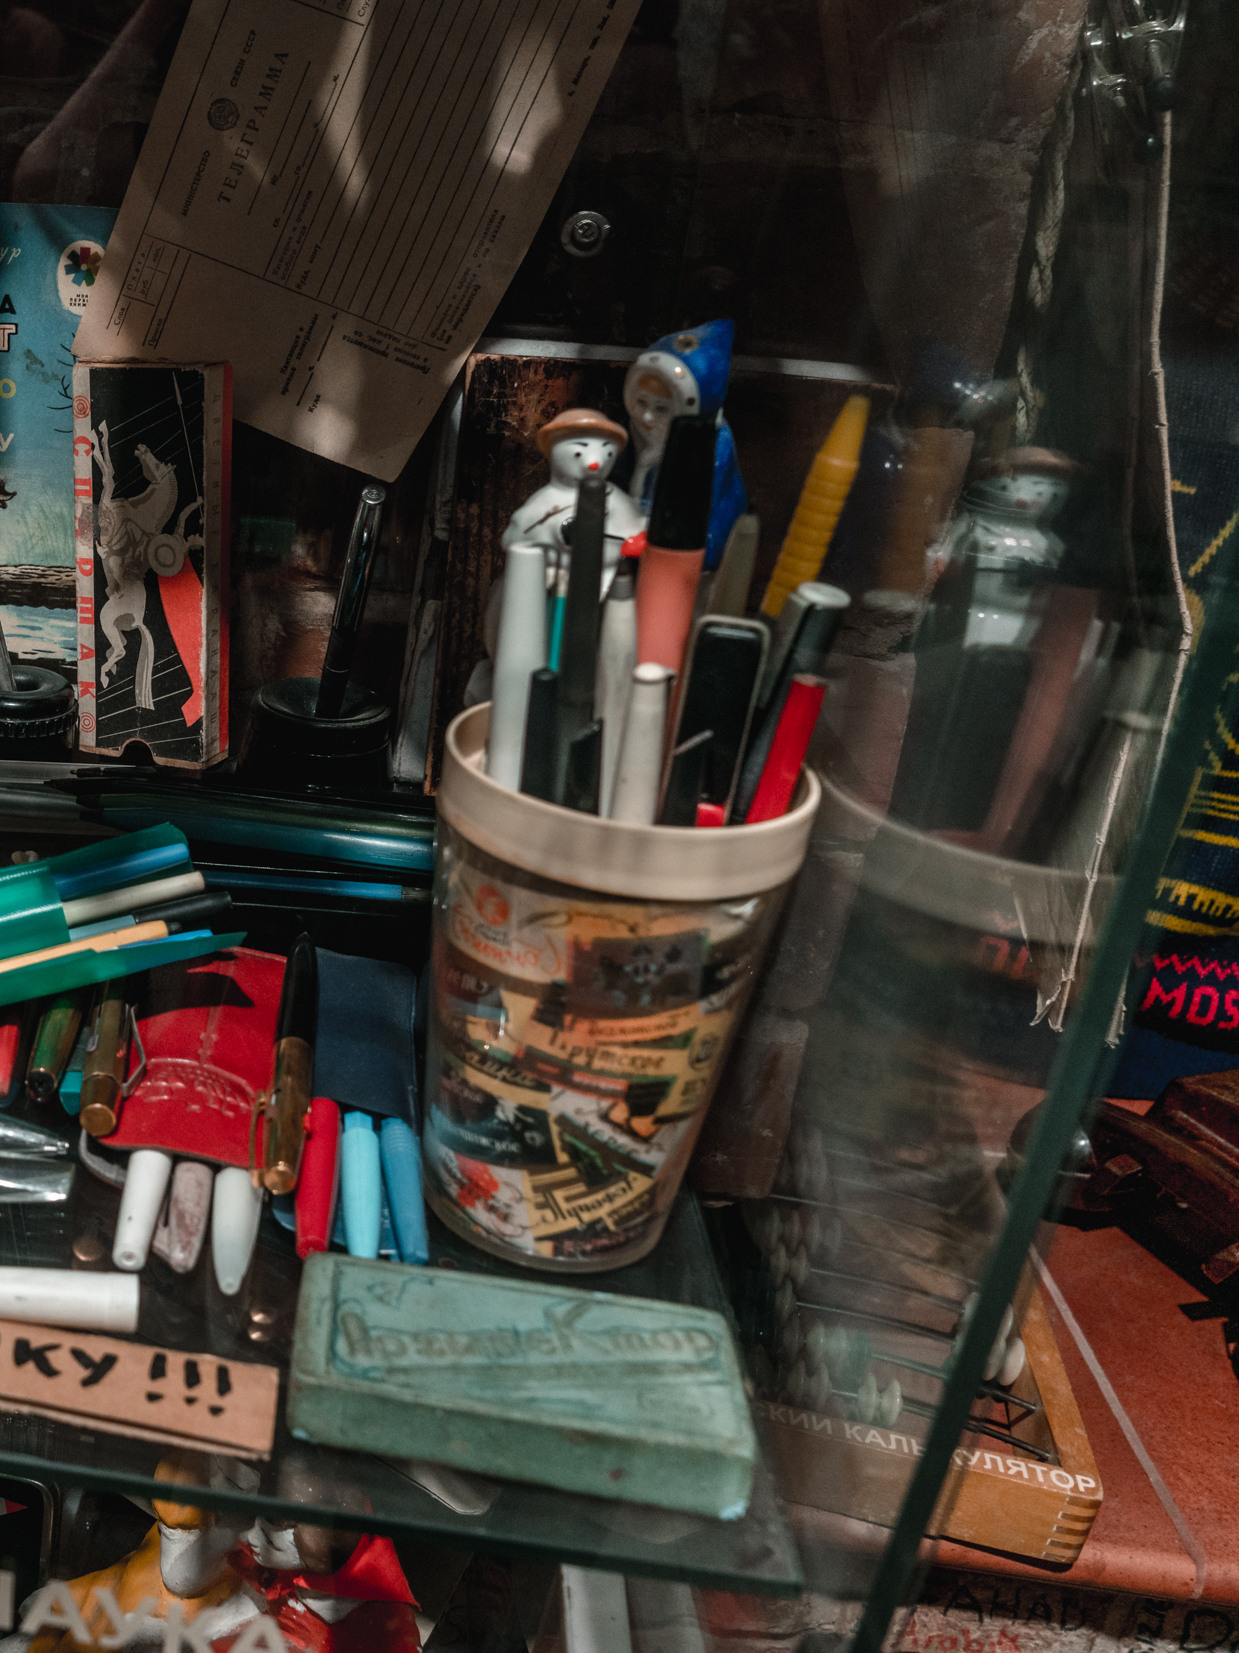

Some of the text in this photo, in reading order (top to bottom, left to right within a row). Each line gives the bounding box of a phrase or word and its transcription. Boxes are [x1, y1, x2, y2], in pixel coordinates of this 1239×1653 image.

[228, 29, 258, 87] СВЯЗИ СССР
[214, 48, 290, 204] ТЕЛЕГРАММА
[178, 149, 212, 216] МИНИСТЕРСТВО
[307, 393, 321, 413] Куда
[1140, 977, 1239, 1030] MOS
